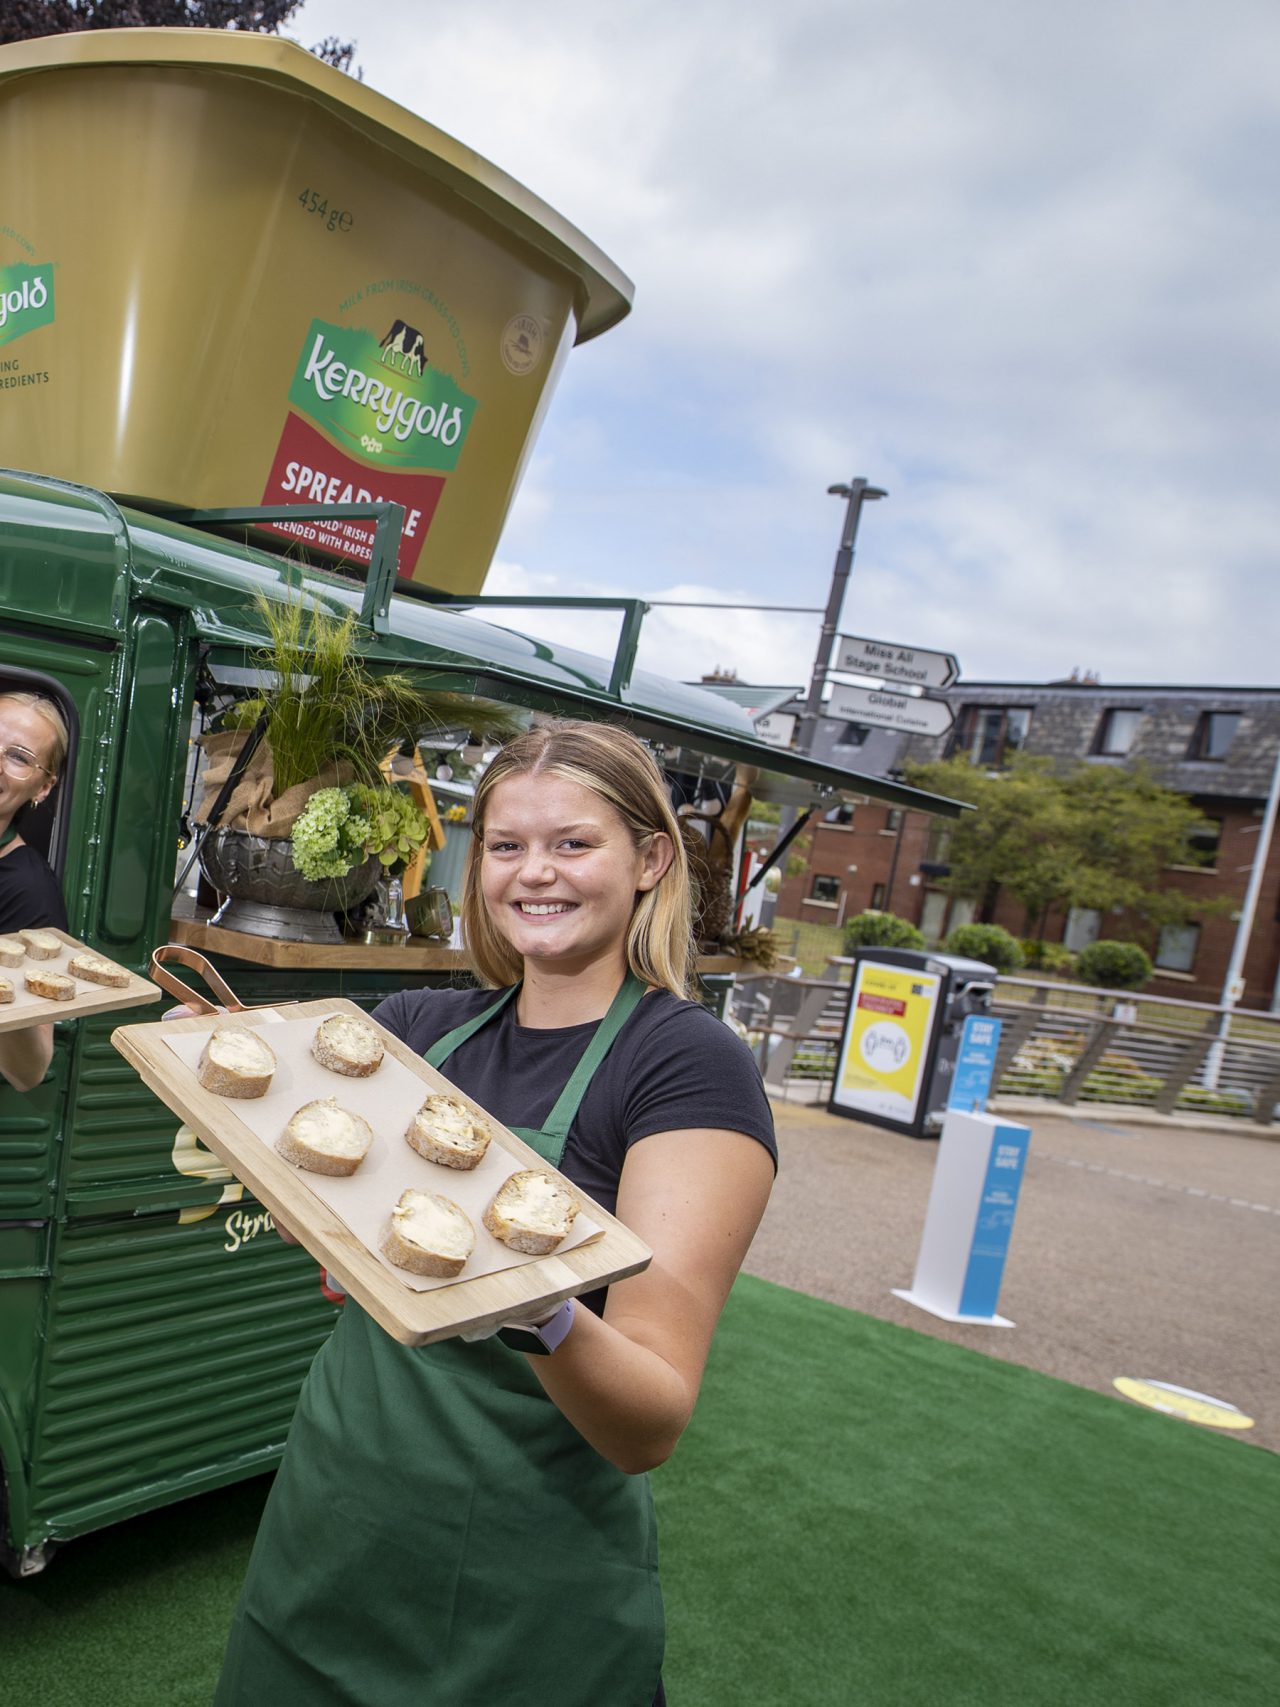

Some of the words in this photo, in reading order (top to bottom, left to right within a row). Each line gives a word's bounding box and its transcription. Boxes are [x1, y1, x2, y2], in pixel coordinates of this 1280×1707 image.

[298, 187, 328, 219] 454
[304, 333, 463, 447] Kerrygold
[318, 531, 343, 549] WITH
[343, 541, 373, 561] RAPES
[342, 524, 368, 543] IRISH
[863, 644, 893, 660] Miss
[897, 650, 915, 664] Ali
[844, 655, 881, 673] Stage
[884, 662, 928, 681] School
[868, 694, 908, 710] Global
[972, 1021, 995, 1034] STAY
[224, 1210, 276, 1252] Stra
